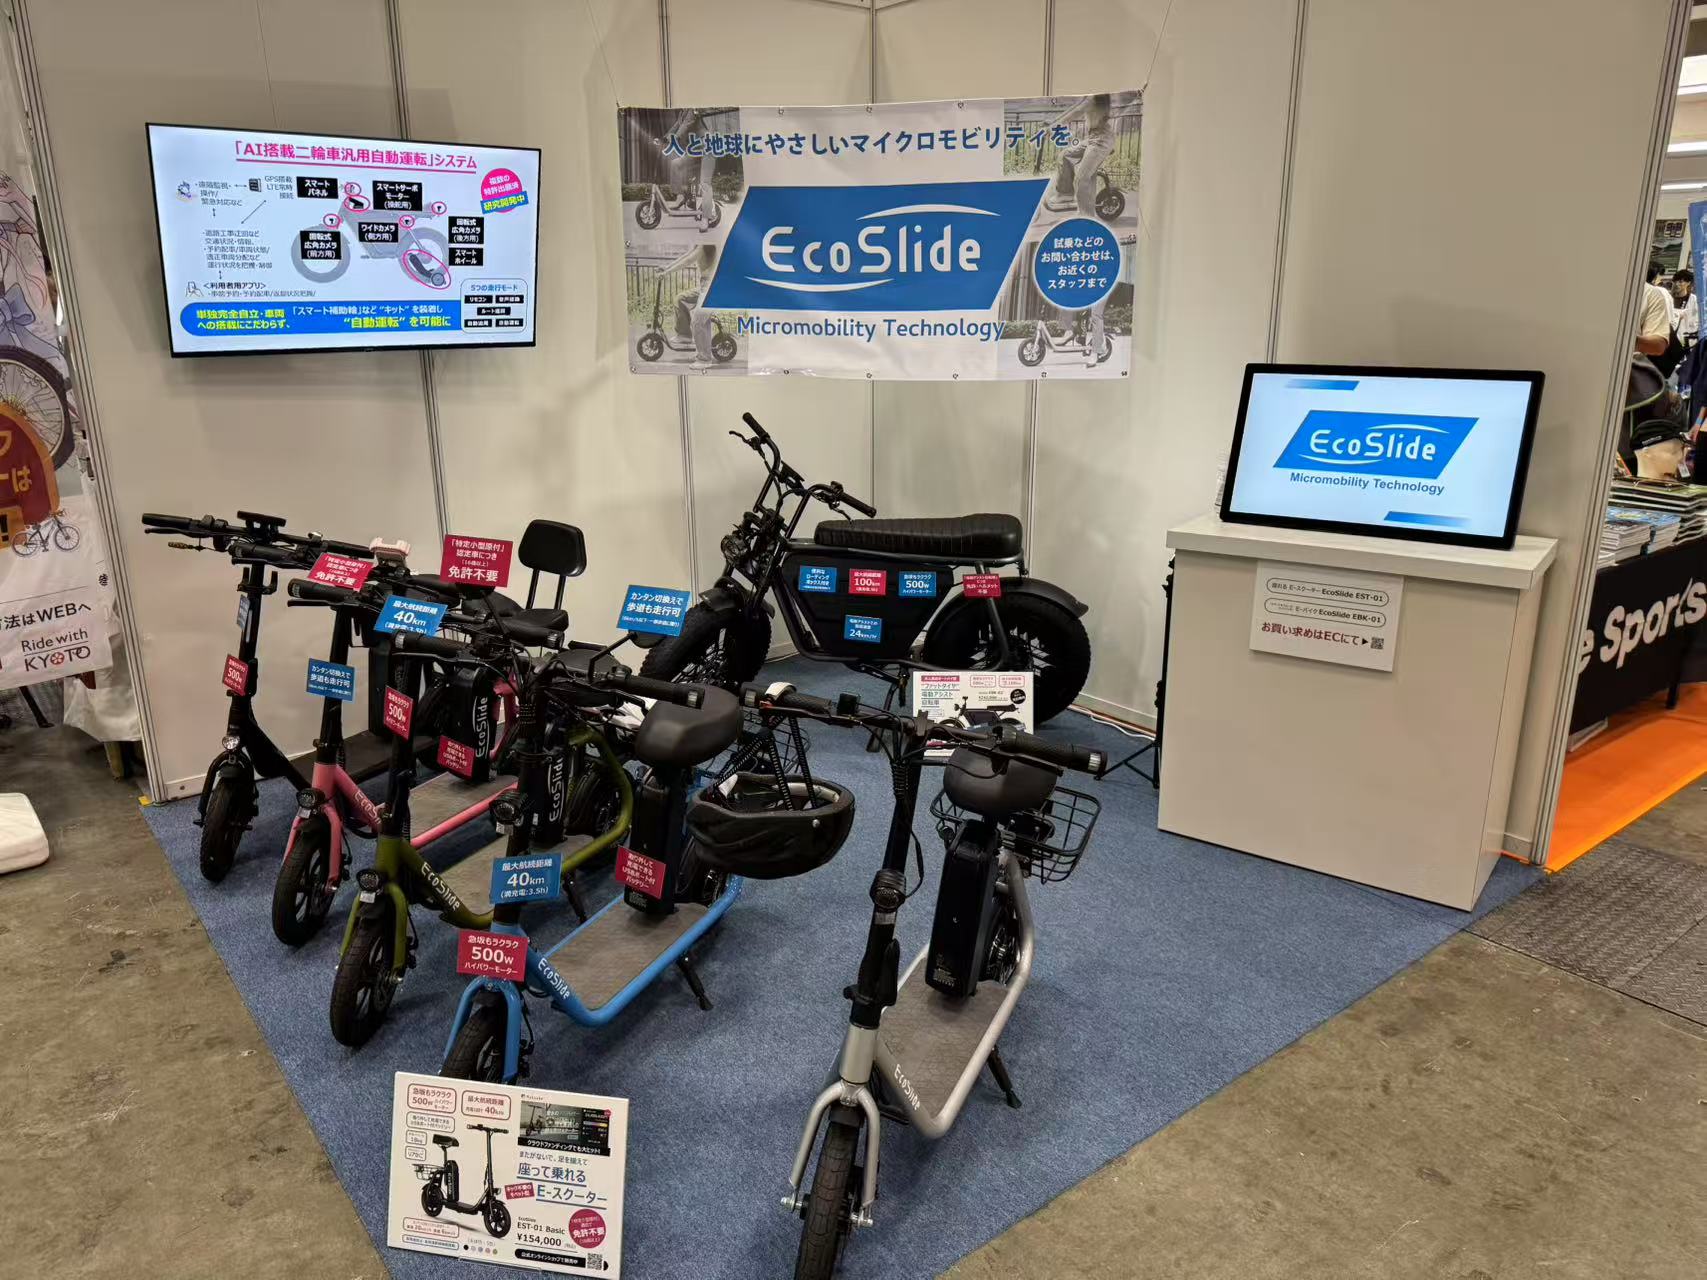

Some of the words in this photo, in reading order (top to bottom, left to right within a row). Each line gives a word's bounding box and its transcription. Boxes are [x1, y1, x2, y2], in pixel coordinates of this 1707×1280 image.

[662, 124, 1084, 157] 人と地球にやさしいマイクロモビリティを。
[235, 141, 477, 169] 「AI搭載二輪車汎用自動運転」システム
[304, 179, 330, 188] スマート
[761, 224, 981, 273] EcoSlide
[1053, 236, 1104, 249] 試乗などの
[1057, 264, 1098, 276] お近くの
[1048, 277, 1107, 289] スタッフまで
[737, 315, 875, 344] Micromobility
[884, 317, 1005, 342] Technology
[1310, 429, 1436, 461] EcoSlide
[1290, 471, 1369, 490] Micromobility
[1374, 478, 1445, 496] Technology
[315, 571, 357, 585] 免許不要
[448, 566, 499, 582] 免許不要
[1322, 588, 1354, 598] EcoSlide
[1355, 592, 1383, 602] EST-01
[0, 603, 91, 631] 法はWEBへ
[393, 610, 426, 626] 40km
[1318, 609, 1351, 619] EcoSlide
[1352, 613, 1381, 623] EBK-01
[1600, 577, 1707, 670] Sports
[21, 637, 54, 652] Ride
[56, 627, 89, 644] with
[1261, 622, 1359, 646] お買い求めはECにて
[475, 696, 488, 758] EcoSlide
[421, 861, 460, 911] EcoSlide
[507, 872, 545, 887] 40km
[467, 935, 519, 949] 急坂もラクラク
[464, 961, 519, 975] ハイパワーモーター
[538, 957, 571, 1000] EcoSlide
[894, 1063, 921, 1111] EcoSlide
[518, 1162, 586, 1182] 座って乗れる
[537, 1184, 607, 1204] E-スクーター
[517, 1222, 543, 1232] EST-01
[545, 1225, 566, 1235] Basic
[517, 1233, 562, 1247] ¥154,000
